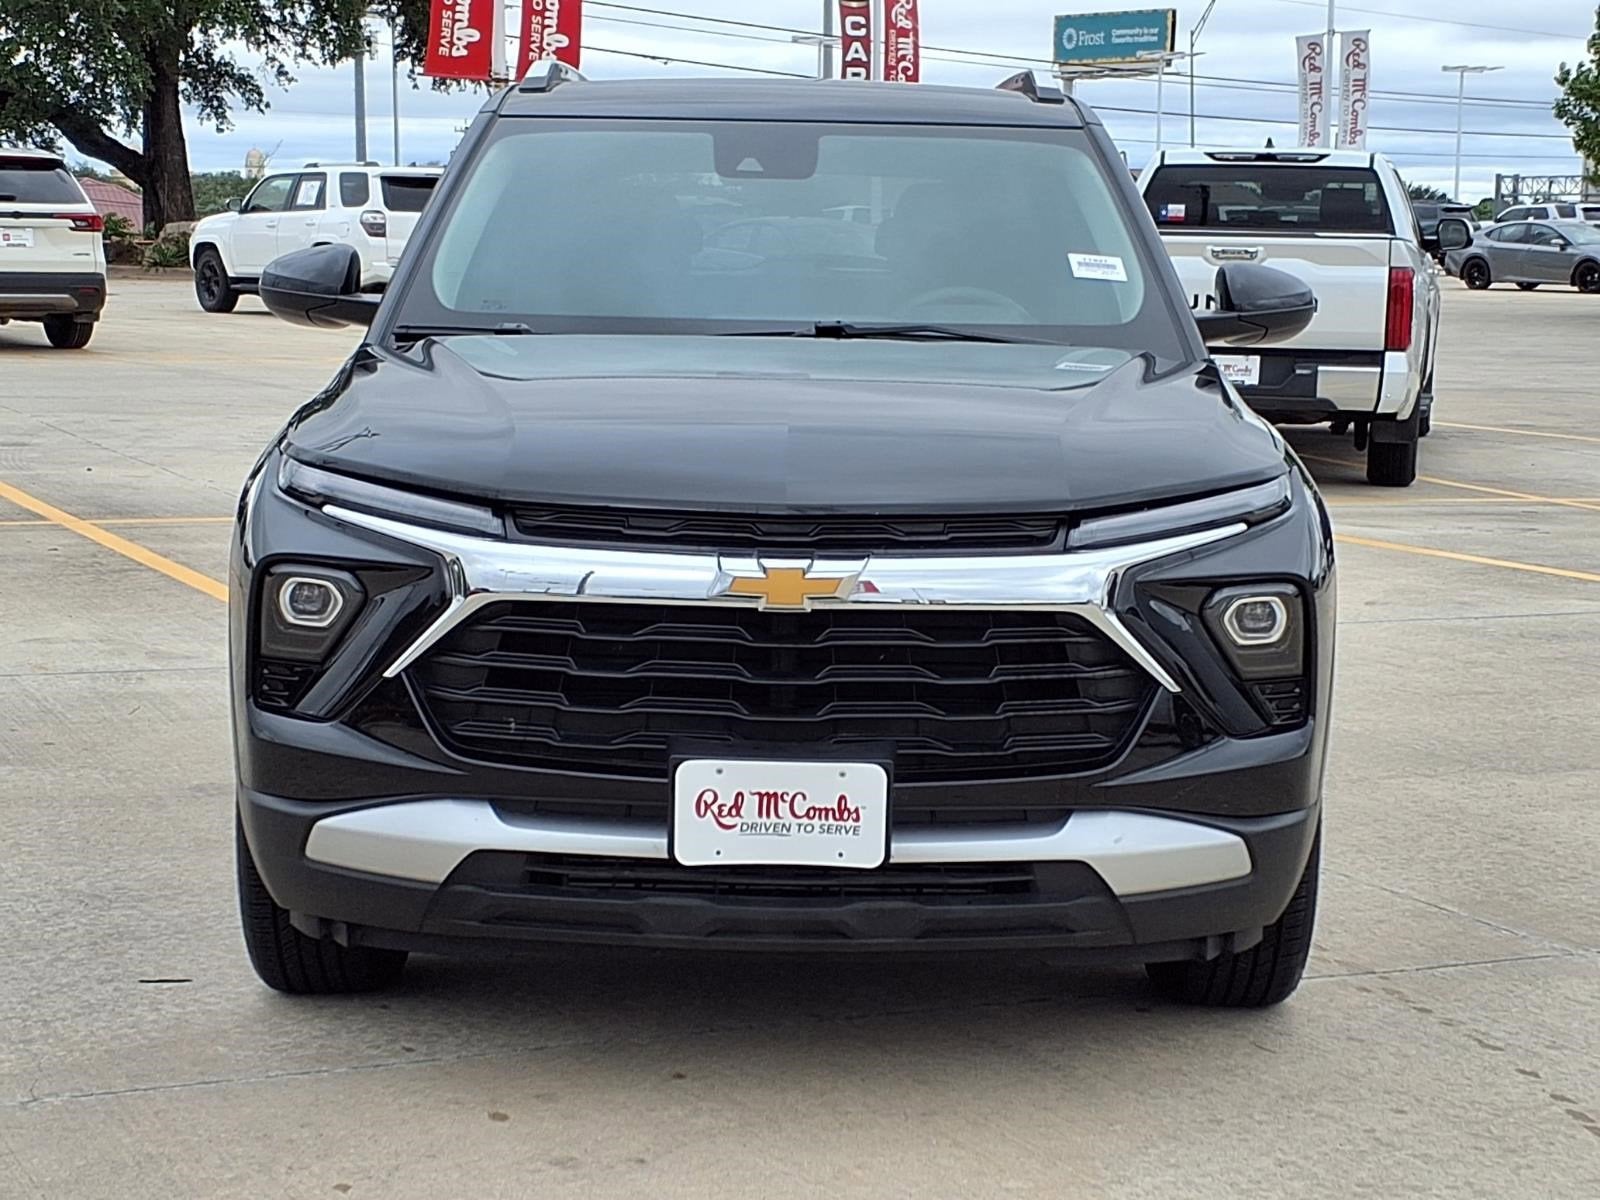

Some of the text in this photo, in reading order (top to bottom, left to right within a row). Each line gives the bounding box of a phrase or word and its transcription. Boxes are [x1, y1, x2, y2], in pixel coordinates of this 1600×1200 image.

[438, 9, 453, 57] SERVE
[528, 15, 542, 61] SERVE
[1078, 30, 1105, 46] Frost
[1302, 42, 1323, 148] Red McCombs
[1345, 38, 1368, 145] Red McCombs
[695, 788, 861, 830] Red McCombs
[739, 822, 861, 837] DRIVEN TO SERVE
